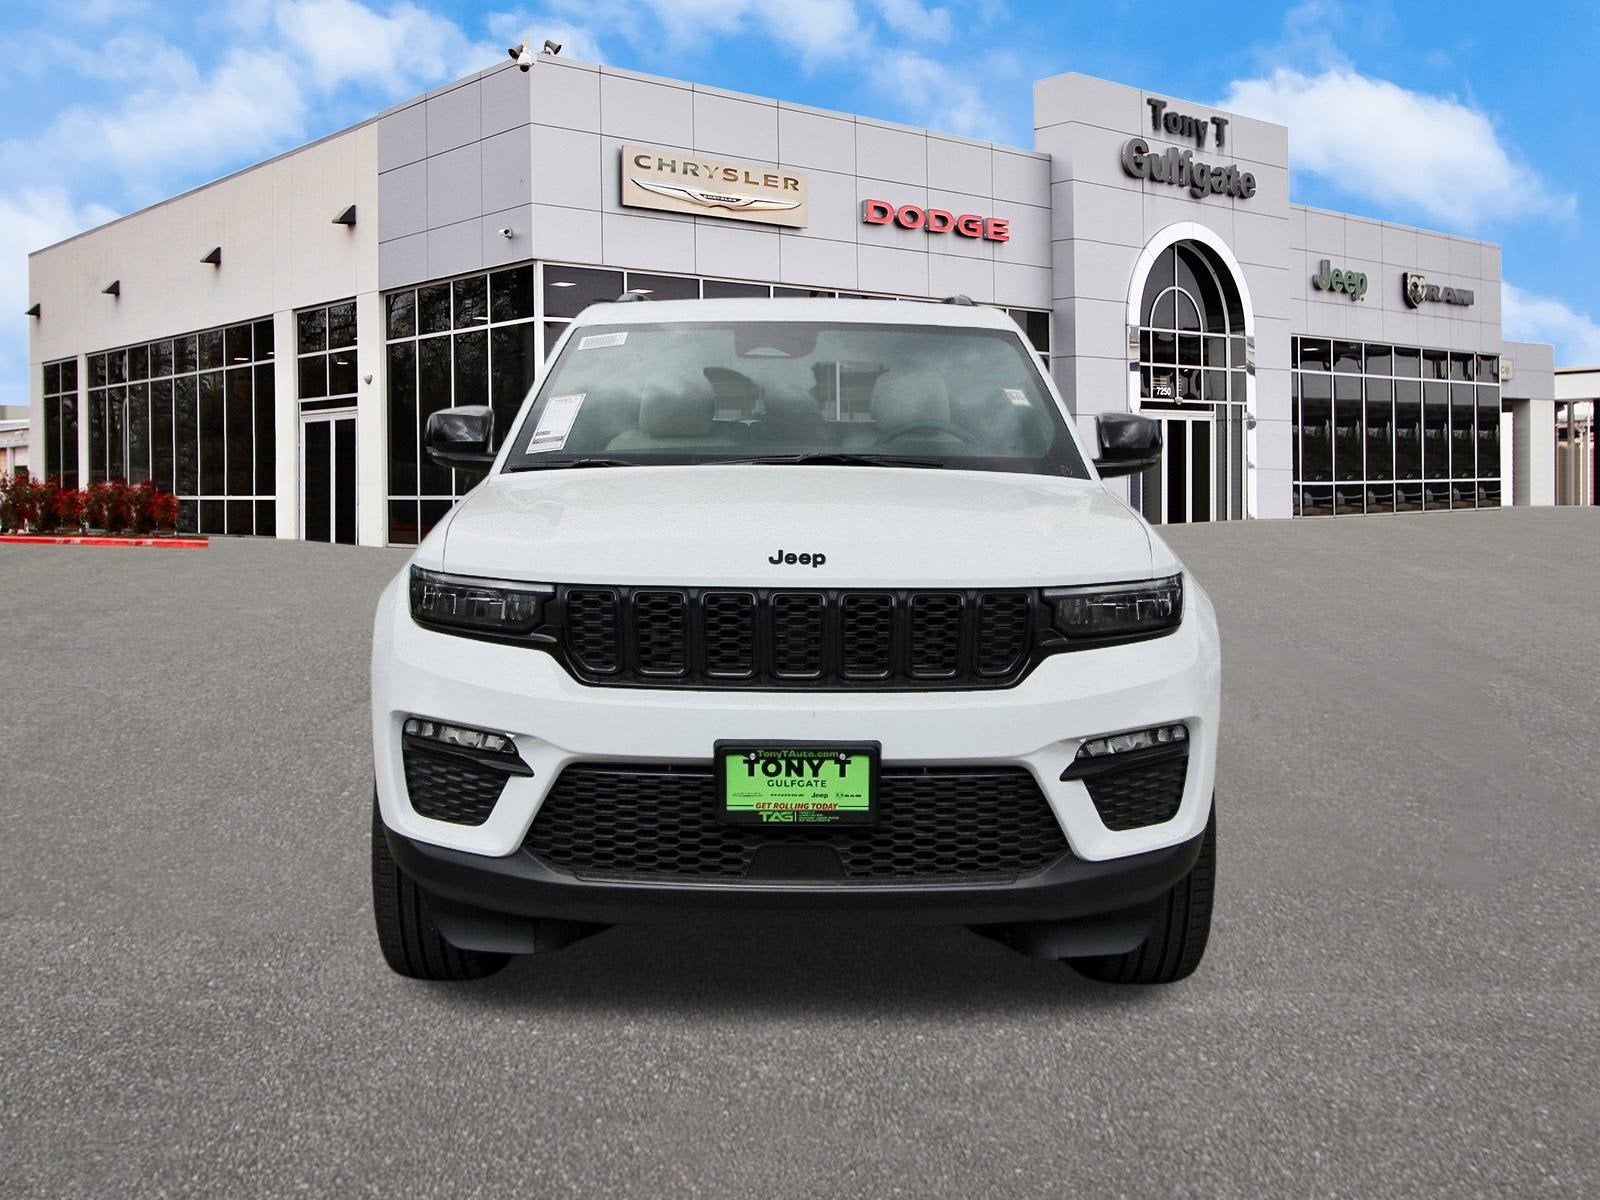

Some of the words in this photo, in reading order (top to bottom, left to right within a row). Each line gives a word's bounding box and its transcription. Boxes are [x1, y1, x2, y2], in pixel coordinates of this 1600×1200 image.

[1147, 98, 1208, 148] Tony
[1211, 117, 1229, 148] T
[633, 154, 801, 192] CHRYSLER
[1121, 138, 1257, 199] Gulfgate
[862, 199, 1010, 242] DODGE
[1312, 259, 1368, 302] Jeep
[1424, 284, 1475, 306] RAM
[1156, 387, 1172, 396] 7250
[768, 549, 826, 568] Jeep
[757, 750, 839, 758] TonyTAuto.com
[743, 758, 823, 777] TONY
[834, 758, 851, 777] T
[767, 779, 827, 788] GULFGATE
[773, 802, 809, 810] ROLLING
[759, 811, 793, 822] TAG
